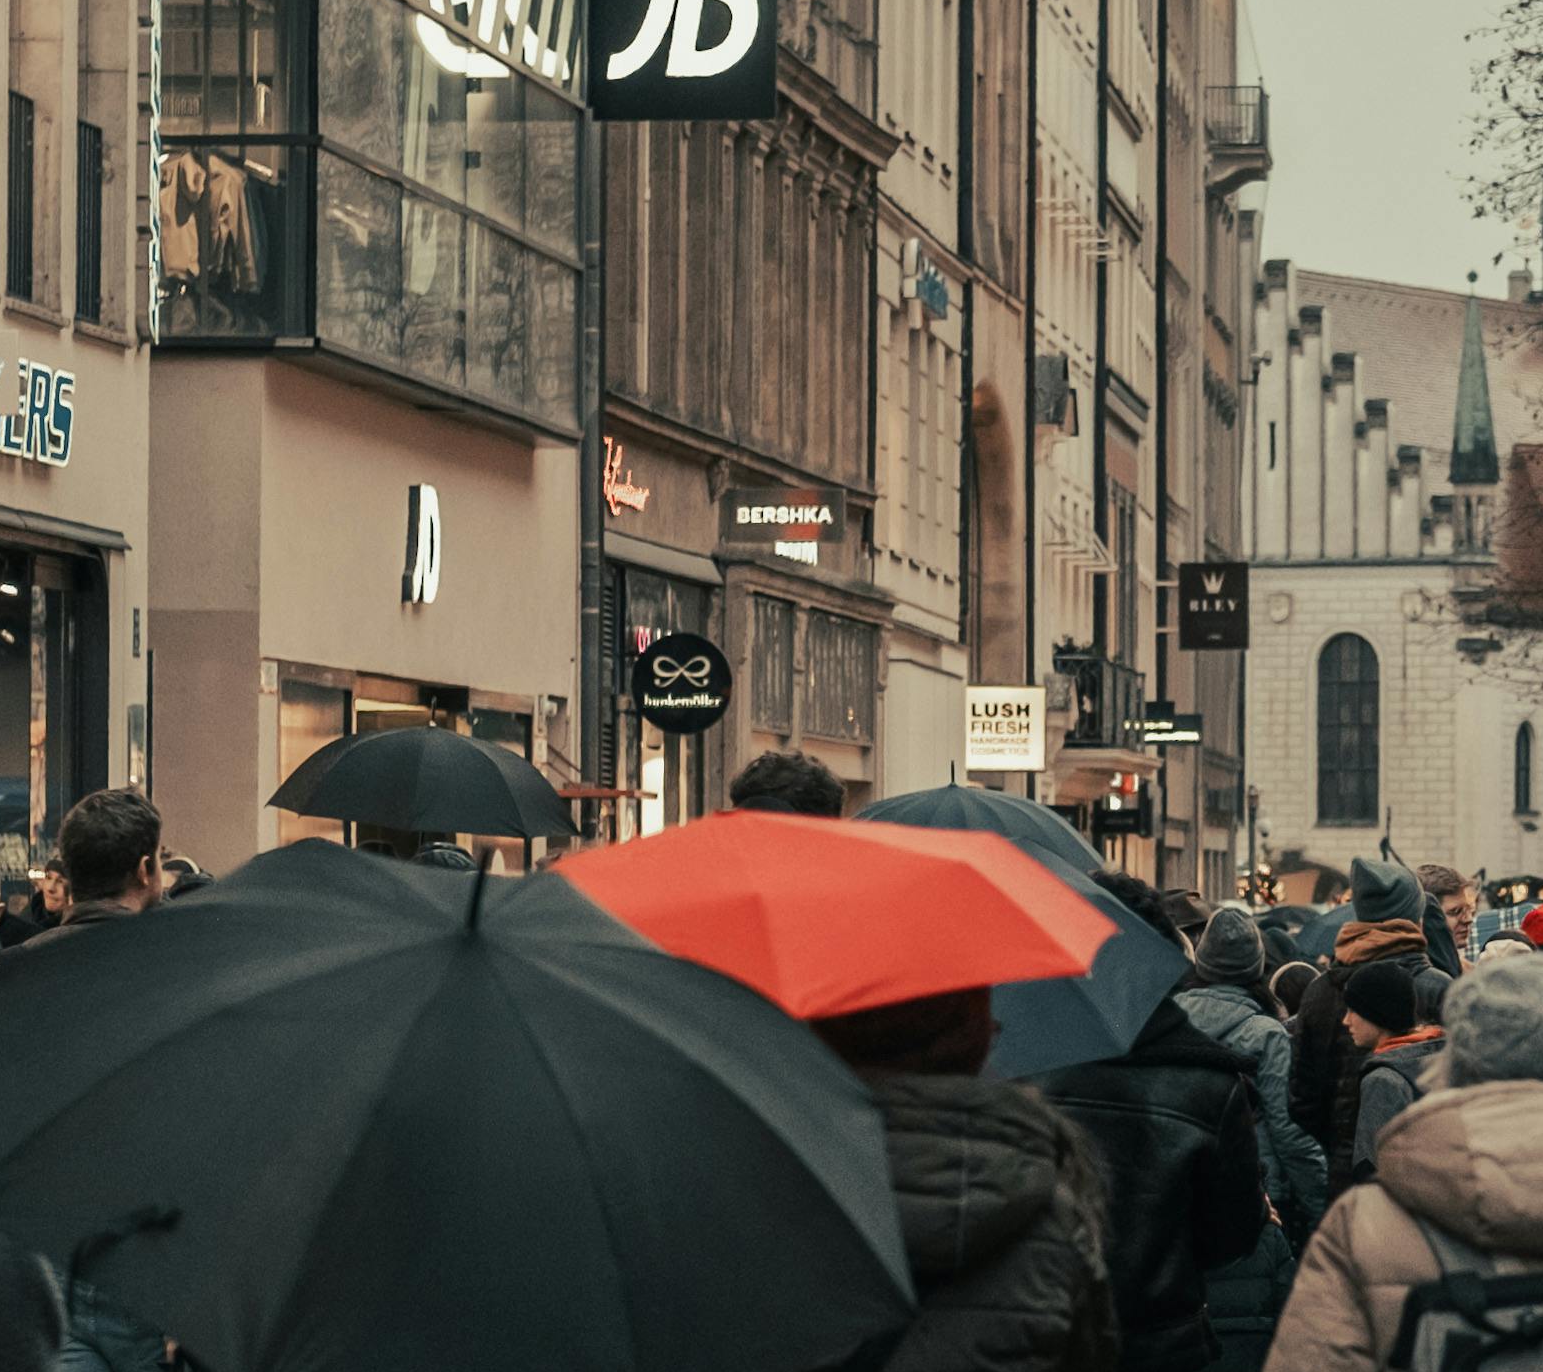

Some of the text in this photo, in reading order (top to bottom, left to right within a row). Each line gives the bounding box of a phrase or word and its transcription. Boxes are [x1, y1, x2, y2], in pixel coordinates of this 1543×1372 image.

[736, 505, 834, 525] BERSHKA
[412, 483, 441, 604] JD
[971, 702, 1030, 718] LUSH
[971, 720, 1030, 734] FRESH
